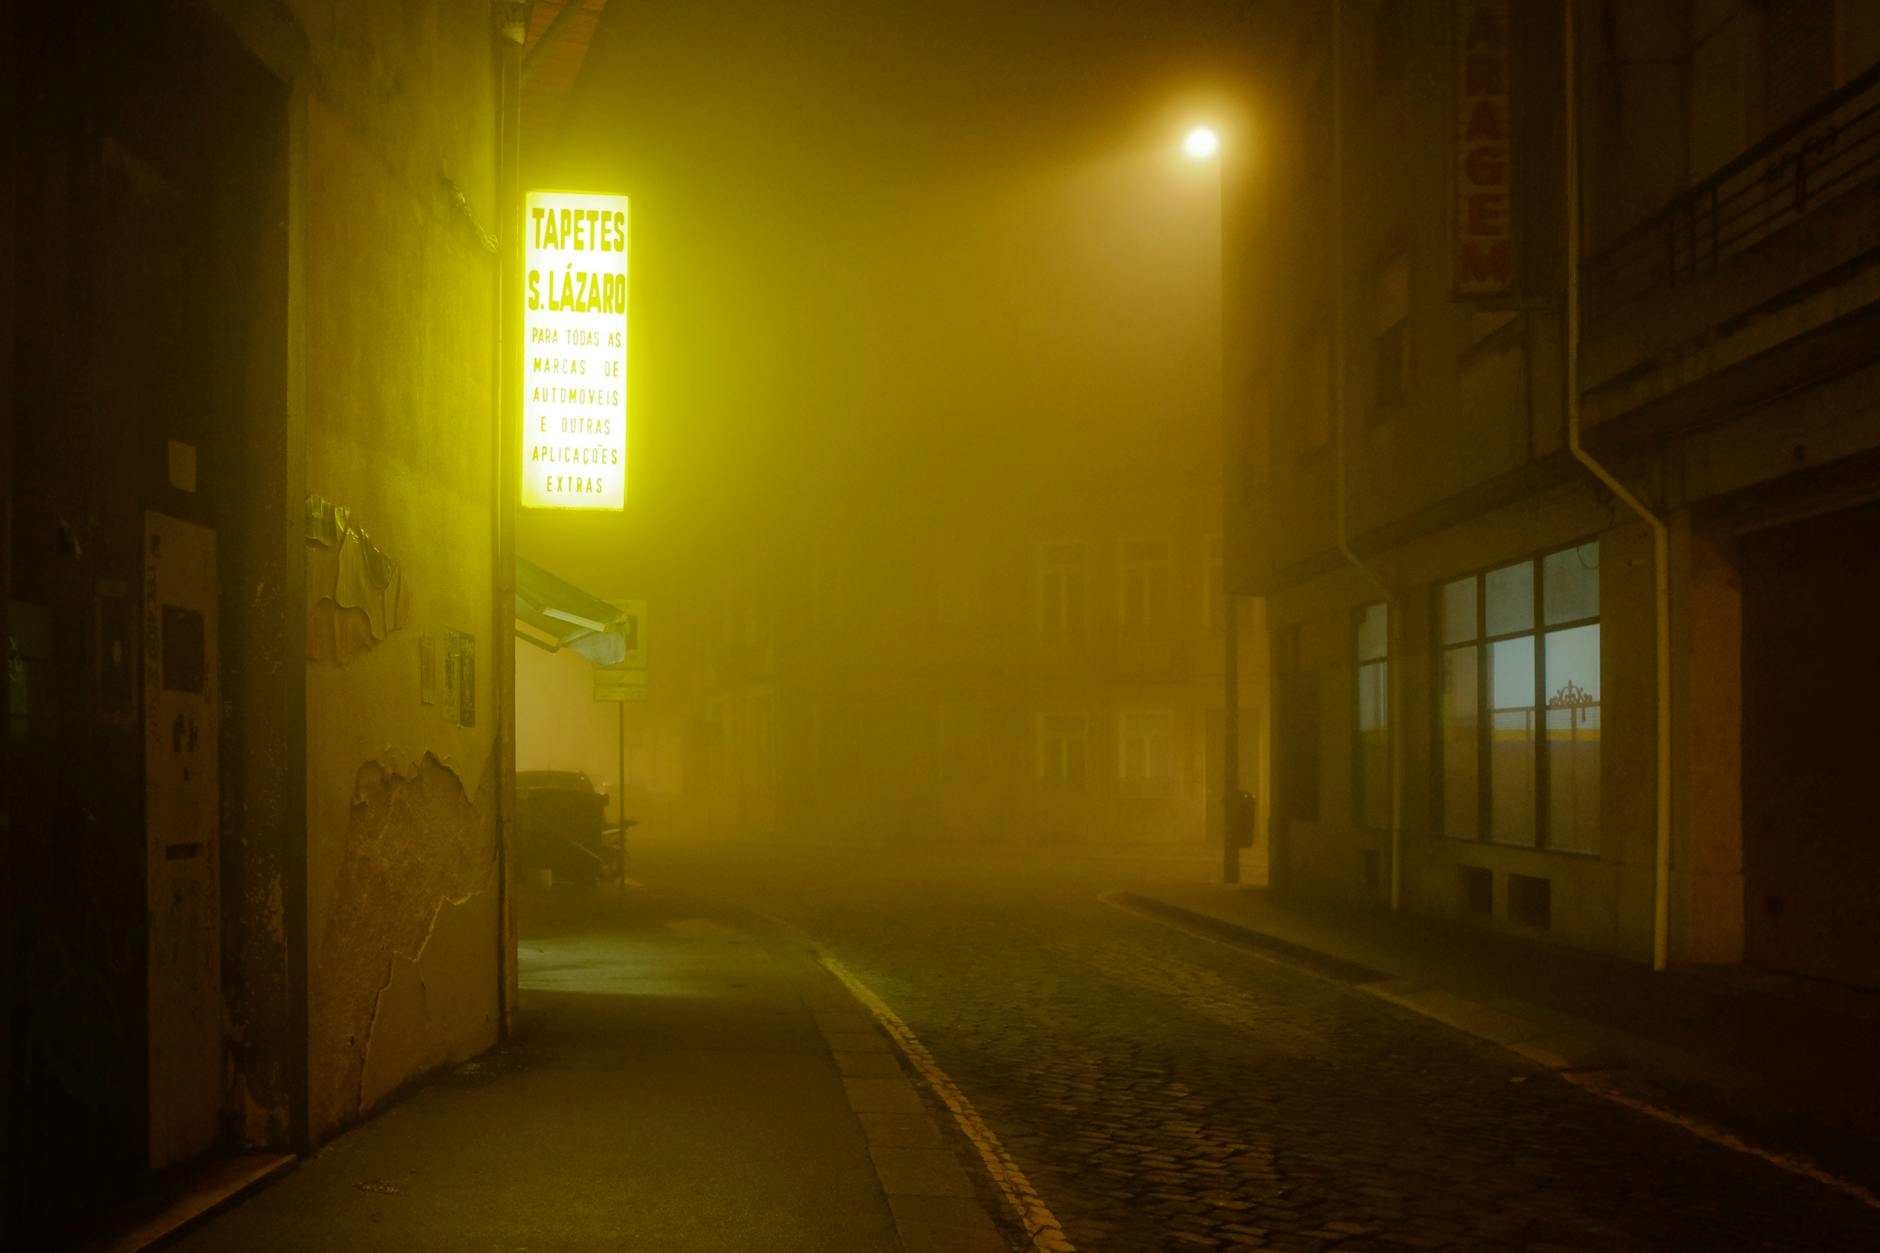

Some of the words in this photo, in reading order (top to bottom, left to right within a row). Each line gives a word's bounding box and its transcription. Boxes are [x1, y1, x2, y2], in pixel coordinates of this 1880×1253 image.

[532, 207, 625, 253] TAPETES
[548, 262, 626, 315] LÁZARO
[531, 326, 558, 345] PARA
[567, 328, 599, 346] TODAS
[607, 331, 621, 349] AS
[532, 357, 585, 375] MARCAS
[605, 360, 619, 378] DE
[540, 416, 547, 432] E
[562, 417, 610, 435] OUTRAS
[546, 475, 603, 494] EXTRAS
